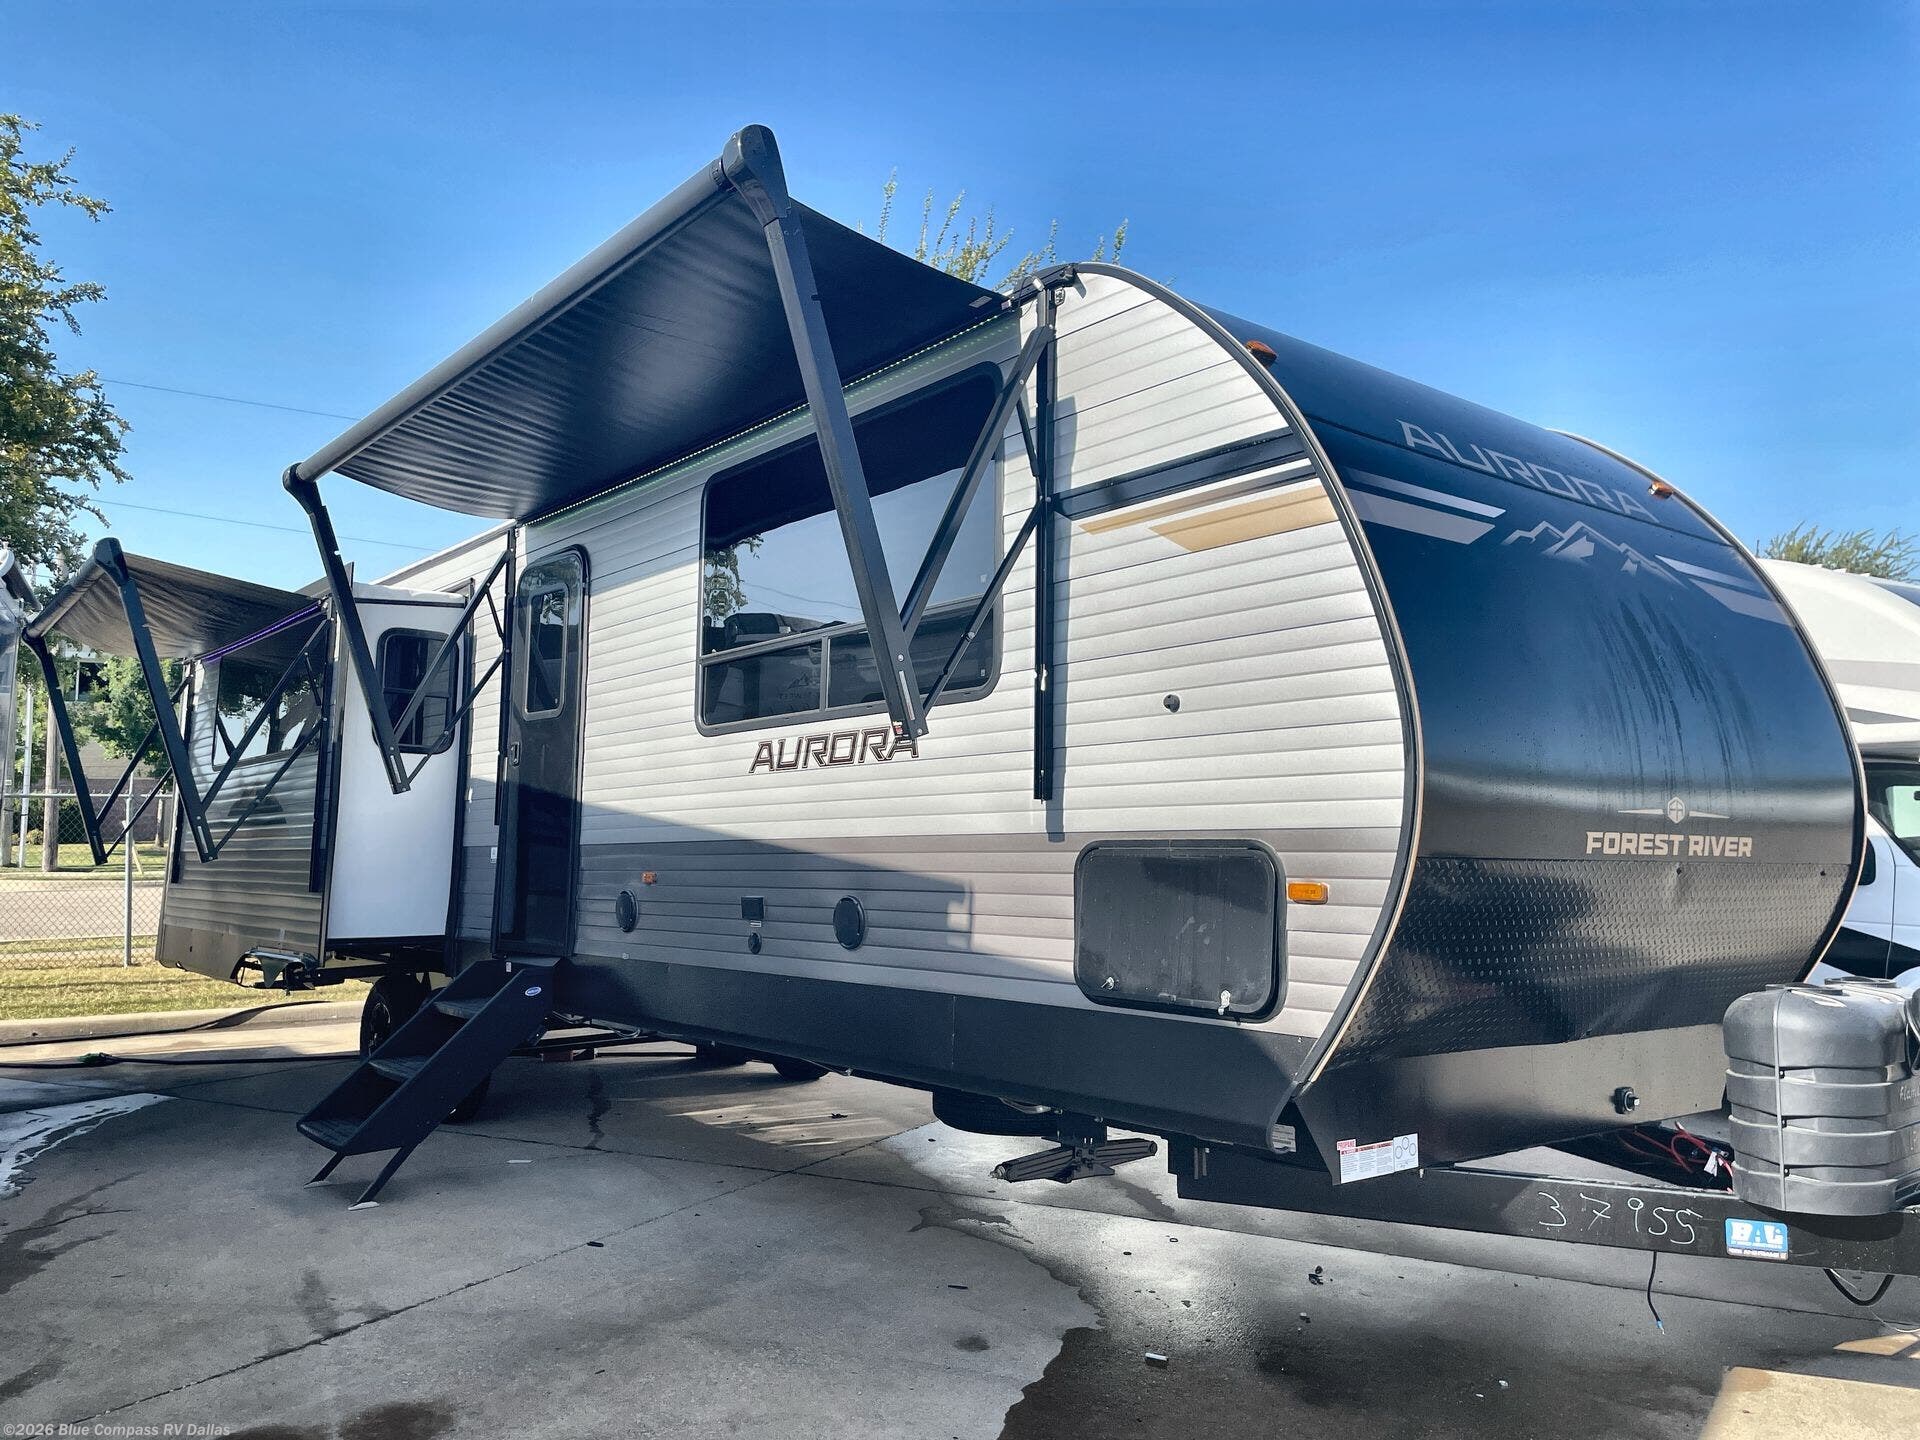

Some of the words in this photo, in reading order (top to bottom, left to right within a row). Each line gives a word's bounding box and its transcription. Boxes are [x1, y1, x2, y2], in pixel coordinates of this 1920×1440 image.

[1396, 419, 1661, 523] AURORA
[748, 725, 919, 774] AURORA
[1585, 831, 1684, 856] FOREST
[1688, 835, 1752, 857] RIVER
[1538, 1191, 1703, 1244] 37955
